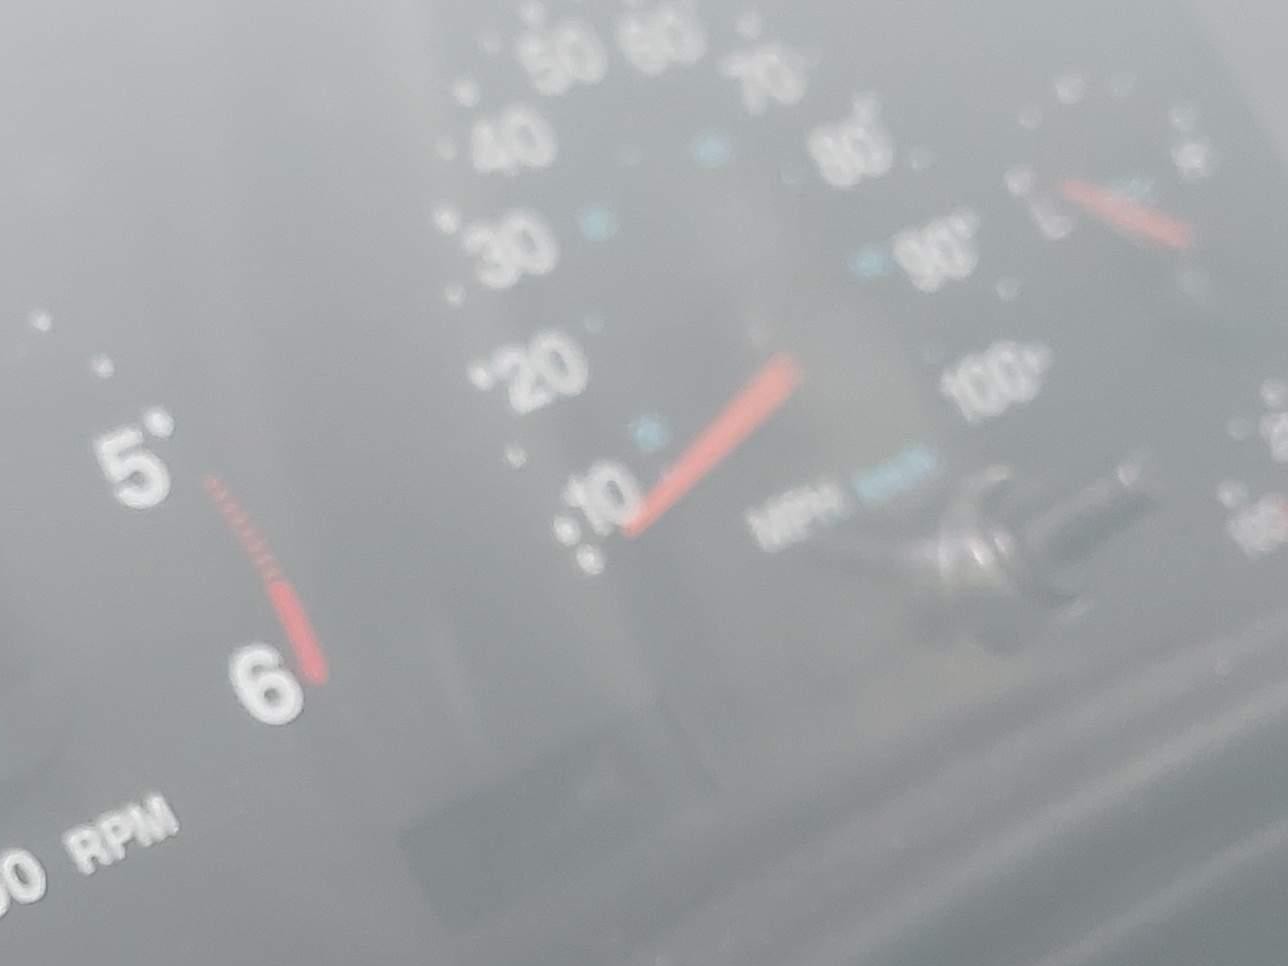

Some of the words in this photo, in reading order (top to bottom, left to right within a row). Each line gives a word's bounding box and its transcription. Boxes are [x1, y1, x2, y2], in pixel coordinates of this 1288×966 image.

[471, 103, 558, 173] 40
[463, 208, 559, 289] 30
[491, 329, 589, 414] 20
[94, 427, 171, 508] 5
[563, 459, 646, 536] 10
[228, 643, 304, 725] 6
[63, 794, 179, 875] RPM
